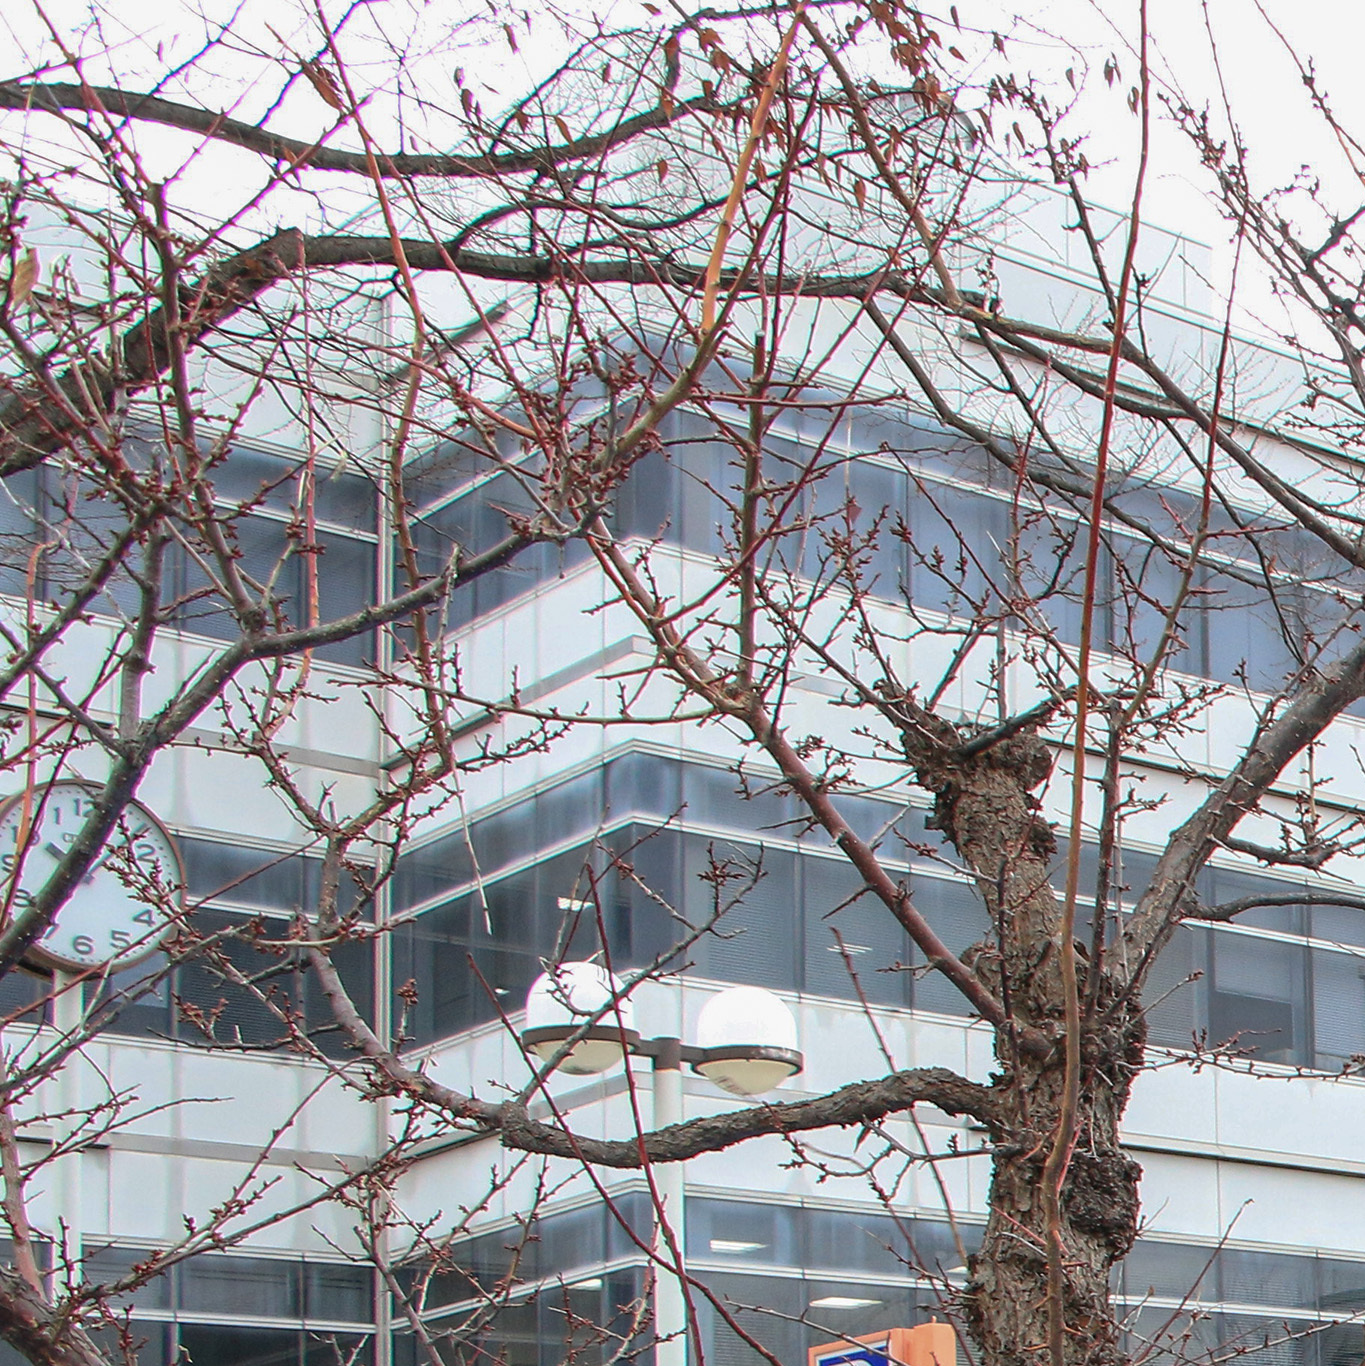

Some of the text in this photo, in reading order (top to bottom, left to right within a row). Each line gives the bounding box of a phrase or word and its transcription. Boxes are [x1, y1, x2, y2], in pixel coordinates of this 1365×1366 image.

[136, 843, 156, 863] 2
[132, 908, 156, 927] 4
[72, 935, 95, 955] 6
[109, 930, 132, 950] 5
